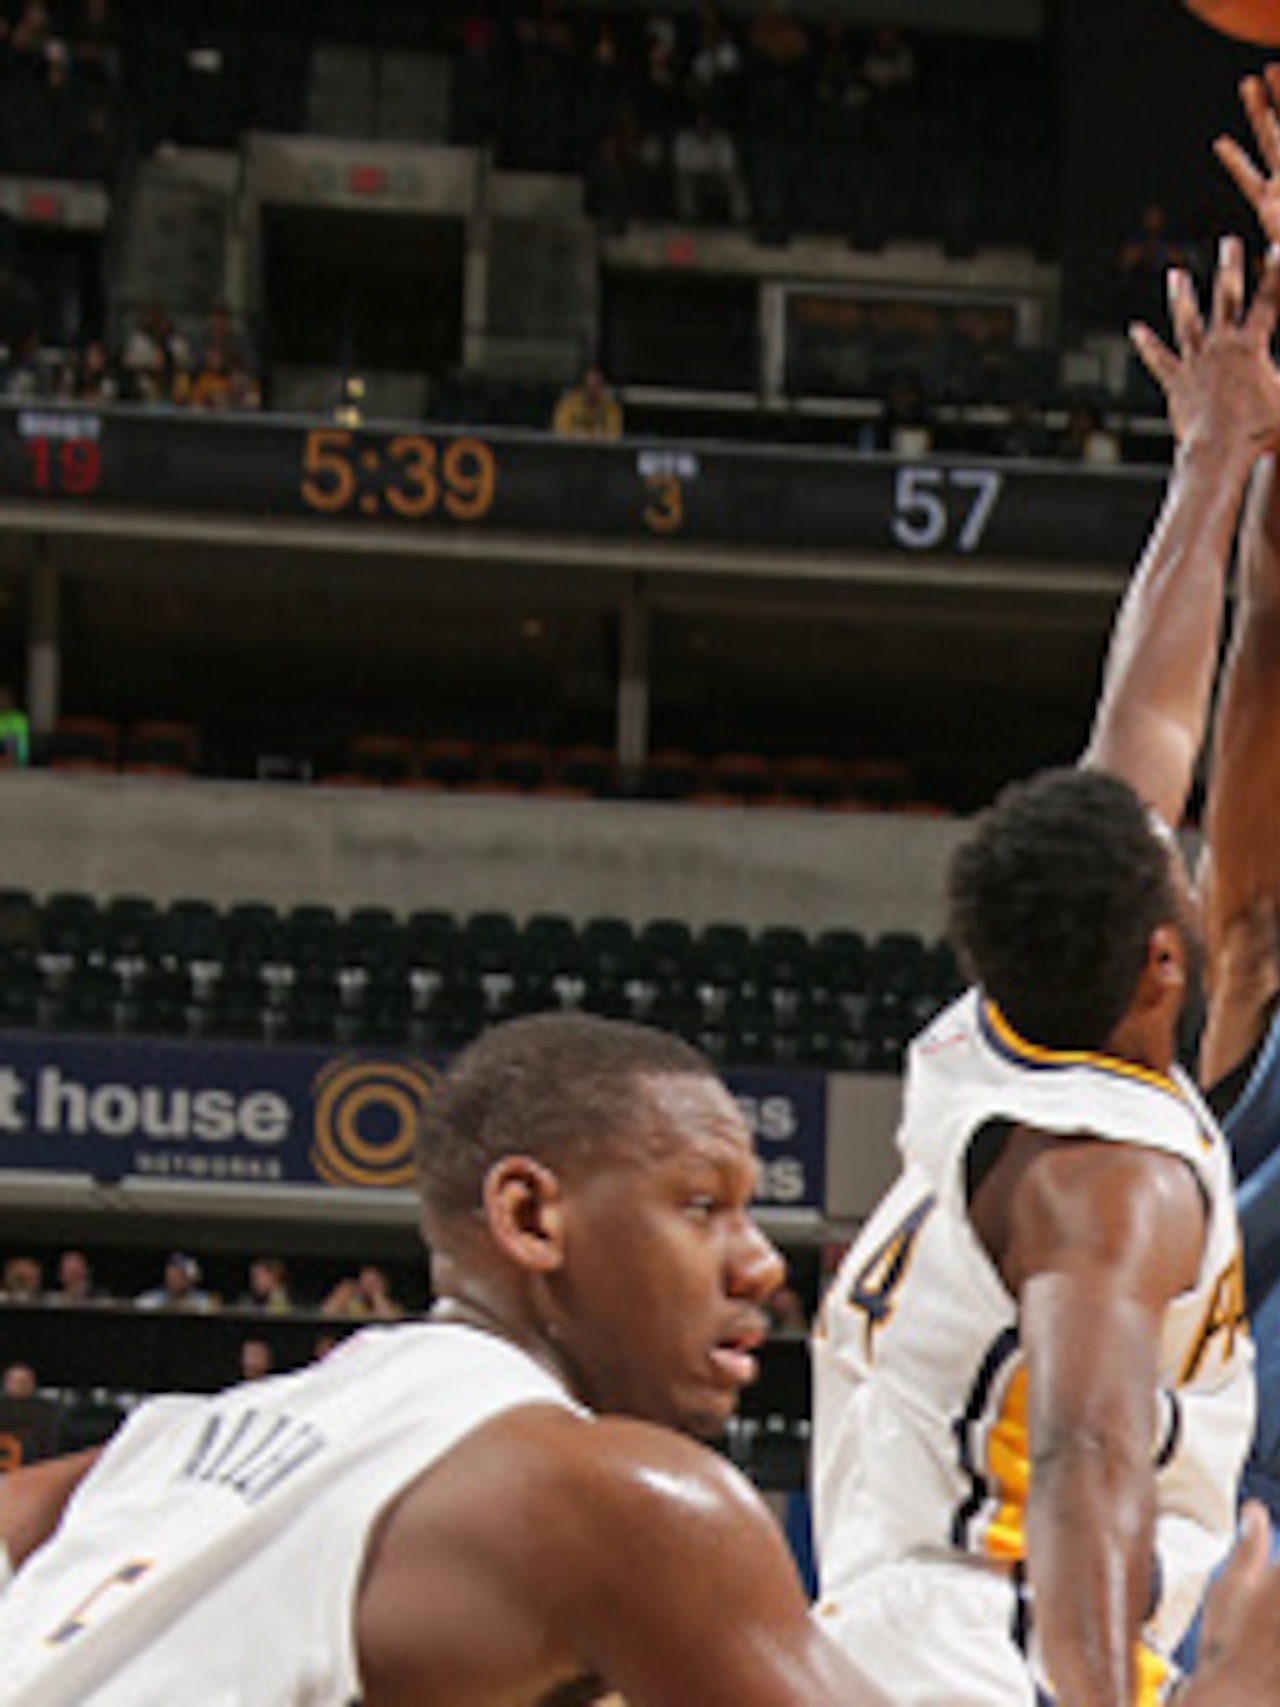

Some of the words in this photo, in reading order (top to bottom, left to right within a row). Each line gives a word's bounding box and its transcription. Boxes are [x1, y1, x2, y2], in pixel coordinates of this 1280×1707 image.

[26, 437, 99, 494] 19
[302, 429, 495, 519] 5:39
[643, 475, 683, 533] 3
[892, 467, 1001, 552] 57
[37, 1064, 291, 1143] house
